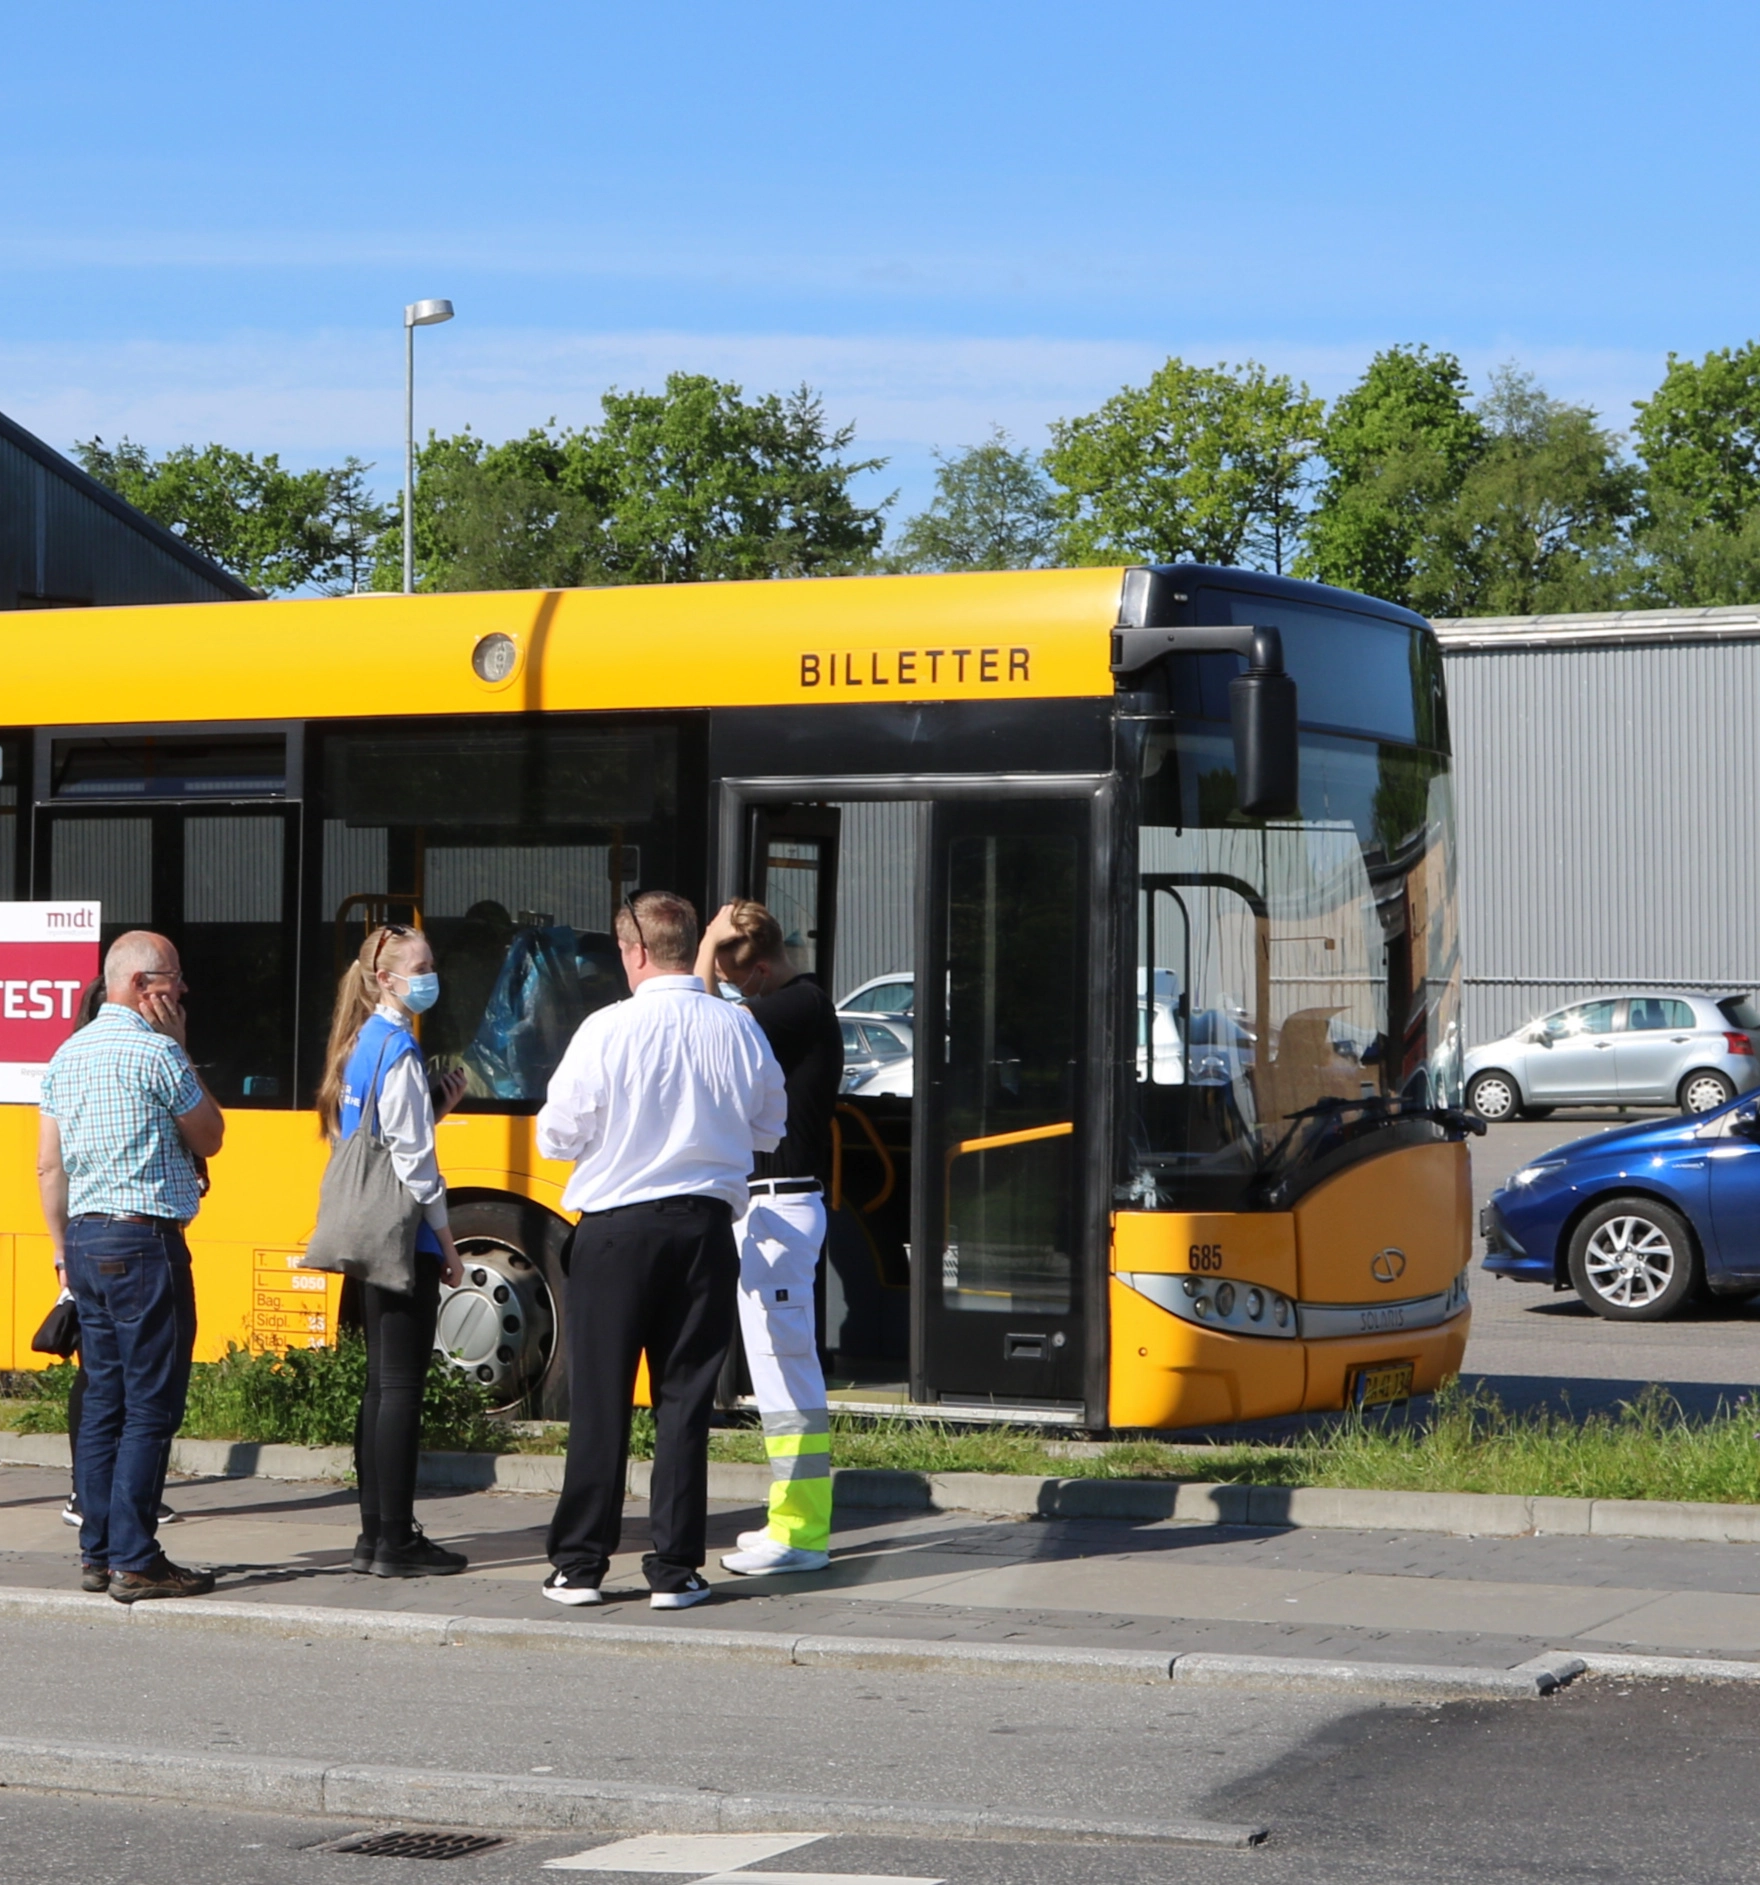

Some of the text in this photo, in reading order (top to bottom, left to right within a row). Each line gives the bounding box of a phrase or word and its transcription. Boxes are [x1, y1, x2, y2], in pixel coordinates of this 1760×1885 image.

[800, 647, 1030, 687] BILLETTER
[46, 908, 94, 928] midt
[1188, 1244, 1223, 1271] 685
[257, 1273, 326, 1291] L. 5050
[257, 1293, 284, 1311] Bag.
[257, 1313, 291, 1331] Sidpl.
